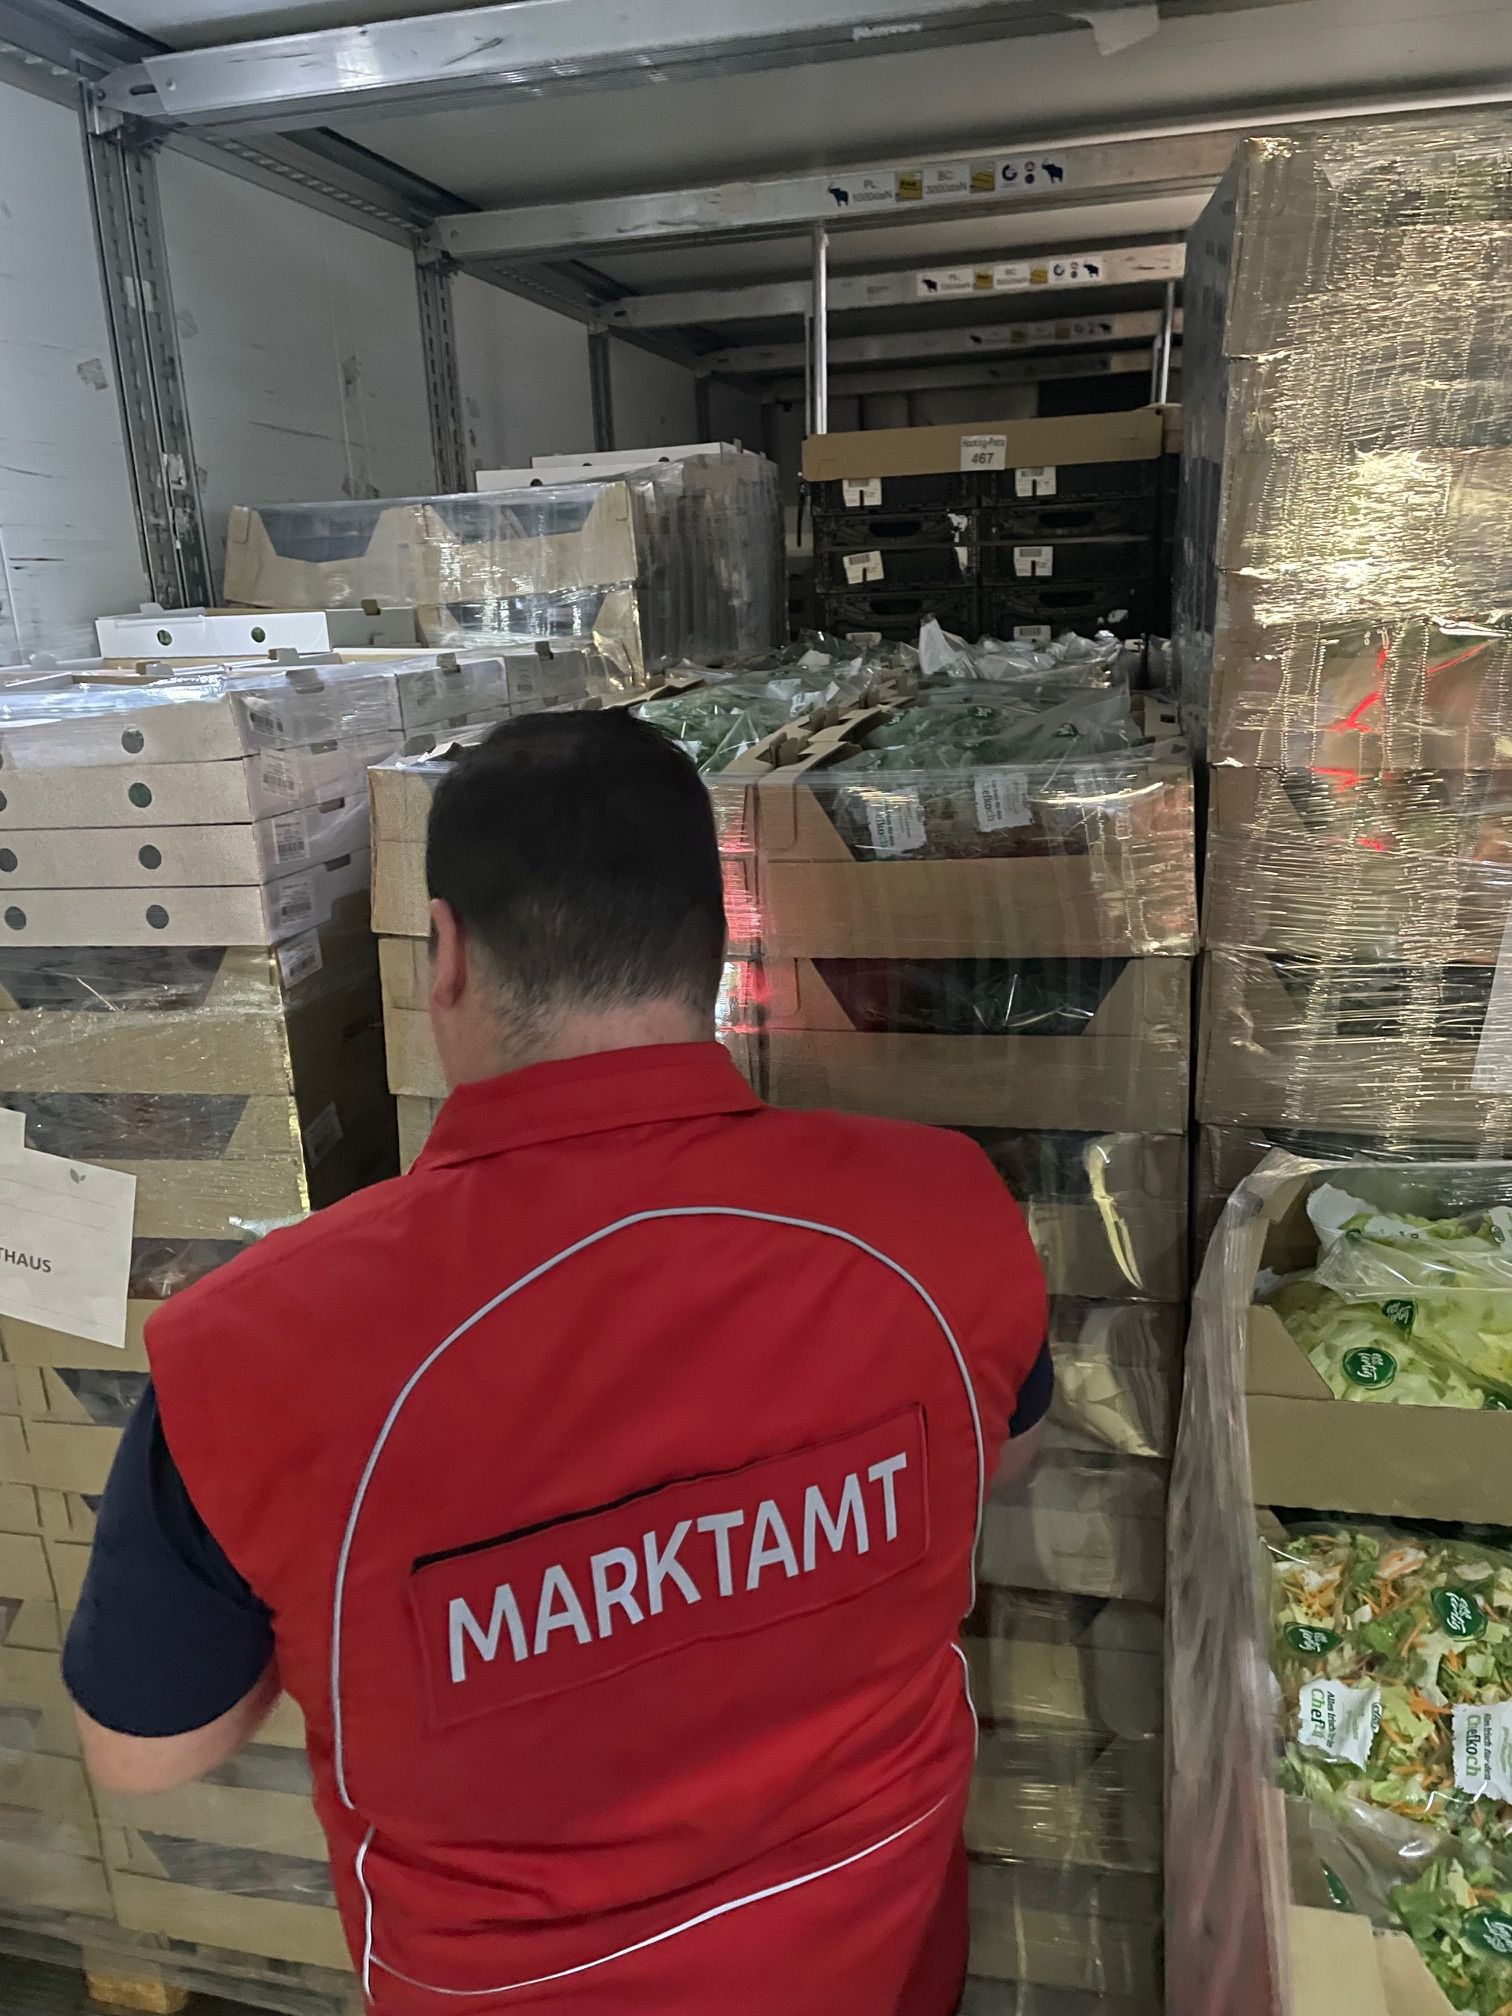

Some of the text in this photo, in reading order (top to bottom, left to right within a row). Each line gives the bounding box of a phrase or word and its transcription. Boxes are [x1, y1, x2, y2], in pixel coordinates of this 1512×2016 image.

[971, 452, 994, 464] 467
[449, 1452, 907, 1683] MARKTAMT
[1327, 1691, 1336, 1712] Alles
[1465, 1714, 1482, 1777] Chefkoch
[1483, 1763, 1492, 1781] den
